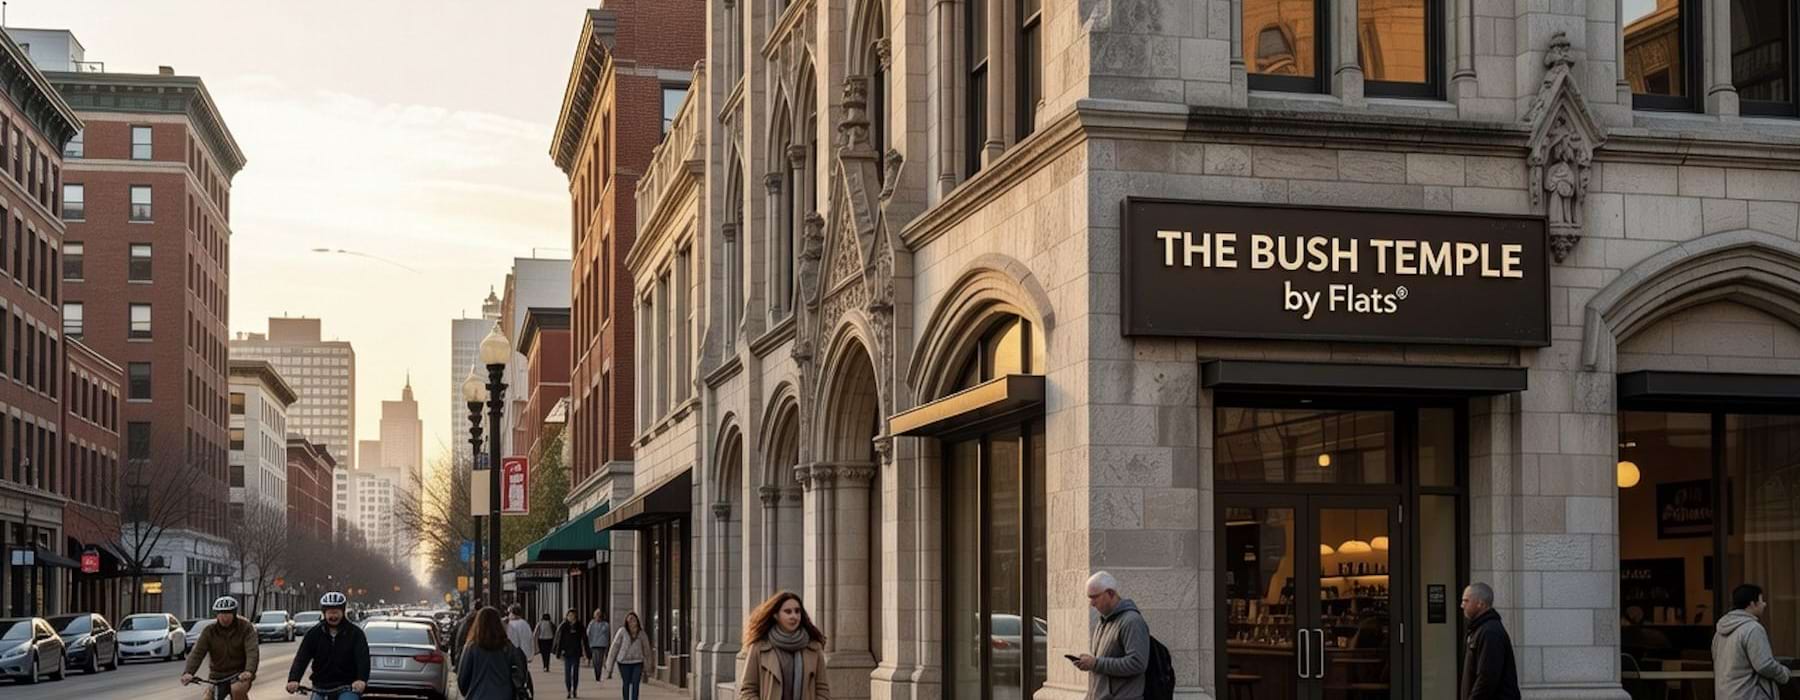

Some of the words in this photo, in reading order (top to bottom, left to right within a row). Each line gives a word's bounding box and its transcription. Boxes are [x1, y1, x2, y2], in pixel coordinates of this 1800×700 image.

[1156, 230, 1238, 269] THE
[1250, 234, 1359, 273] BUSH
[1369, 238, 1524, 279] TEMPLE
[1284, 280, 1321, 320] by
[1328, 284, 1409, 314] Flats®
